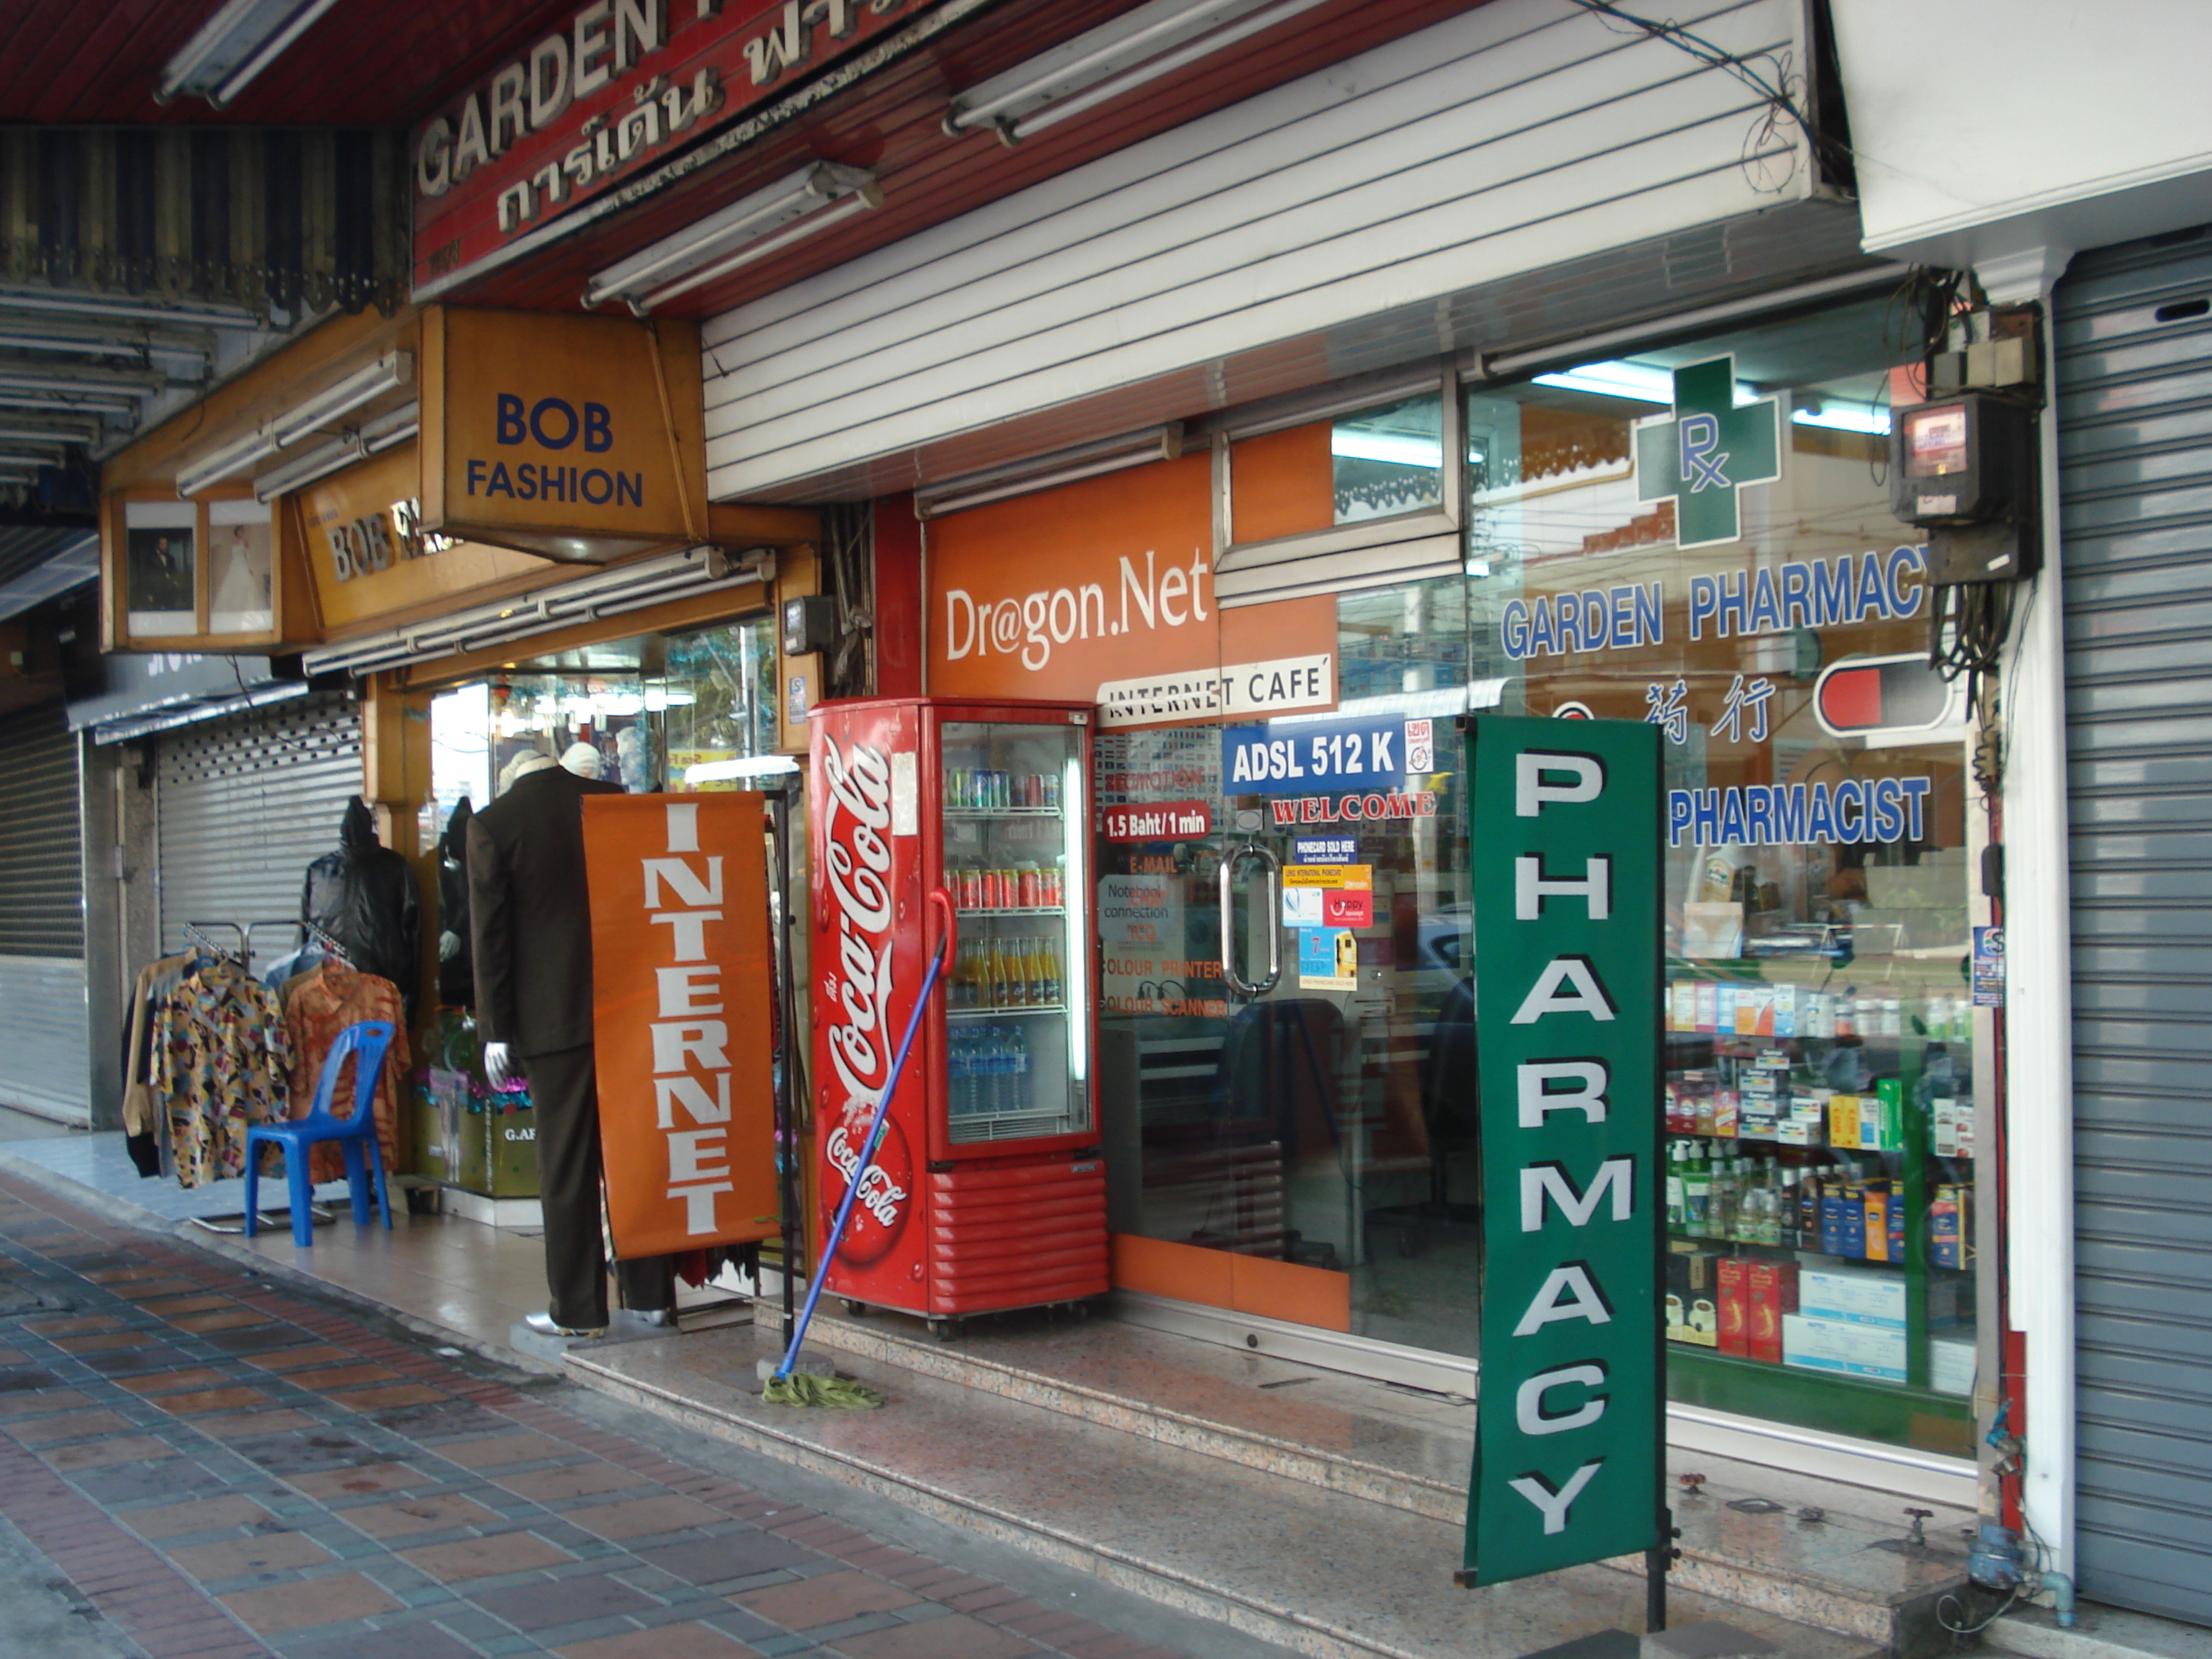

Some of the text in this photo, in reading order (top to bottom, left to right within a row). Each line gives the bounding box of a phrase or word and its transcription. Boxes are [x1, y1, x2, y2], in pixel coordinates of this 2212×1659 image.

[743, 0, 892, 86] ฟา
[418, 0, 659, 197] GARDEN
[497, 392, 613, 453] BOB
[468, 459, 642, 507] FASHION
[326, 512, 392, 582] BOB
[946, 547, 1208, 670] Dr@gon.Net
[1502, 582, 1664, 660] GARDEN
[1110, 678, 1234, 718] INTERNET
[1233, 732, 1394, 783] ADSL 512 K
[1107, 814, 1127, 837] 1.5
[1179, 809, 1205, 834] min
[1271, 791, 1437, 825] WELCOME
[1670, 775, 1931, 848] PHARMACIST
[1130, 855, 1177, 873] E-MAIL
[1298, 840, 1354, 853] PHONECARD SOLD HERE
[823, 732, 894, 1100] Coca-Cola
[1105, 906, 1169, 920] connection
[1102, 958, 1224, 979] OLOUR PRINTER
[1311, 937, 1321, 955] 7
[641, 803, 734, 1236] INTERNET
[1102, 996, 1228, 1017] OLOUR SCANNER
[1508, 750, 1635, 1535] PHARMACY
